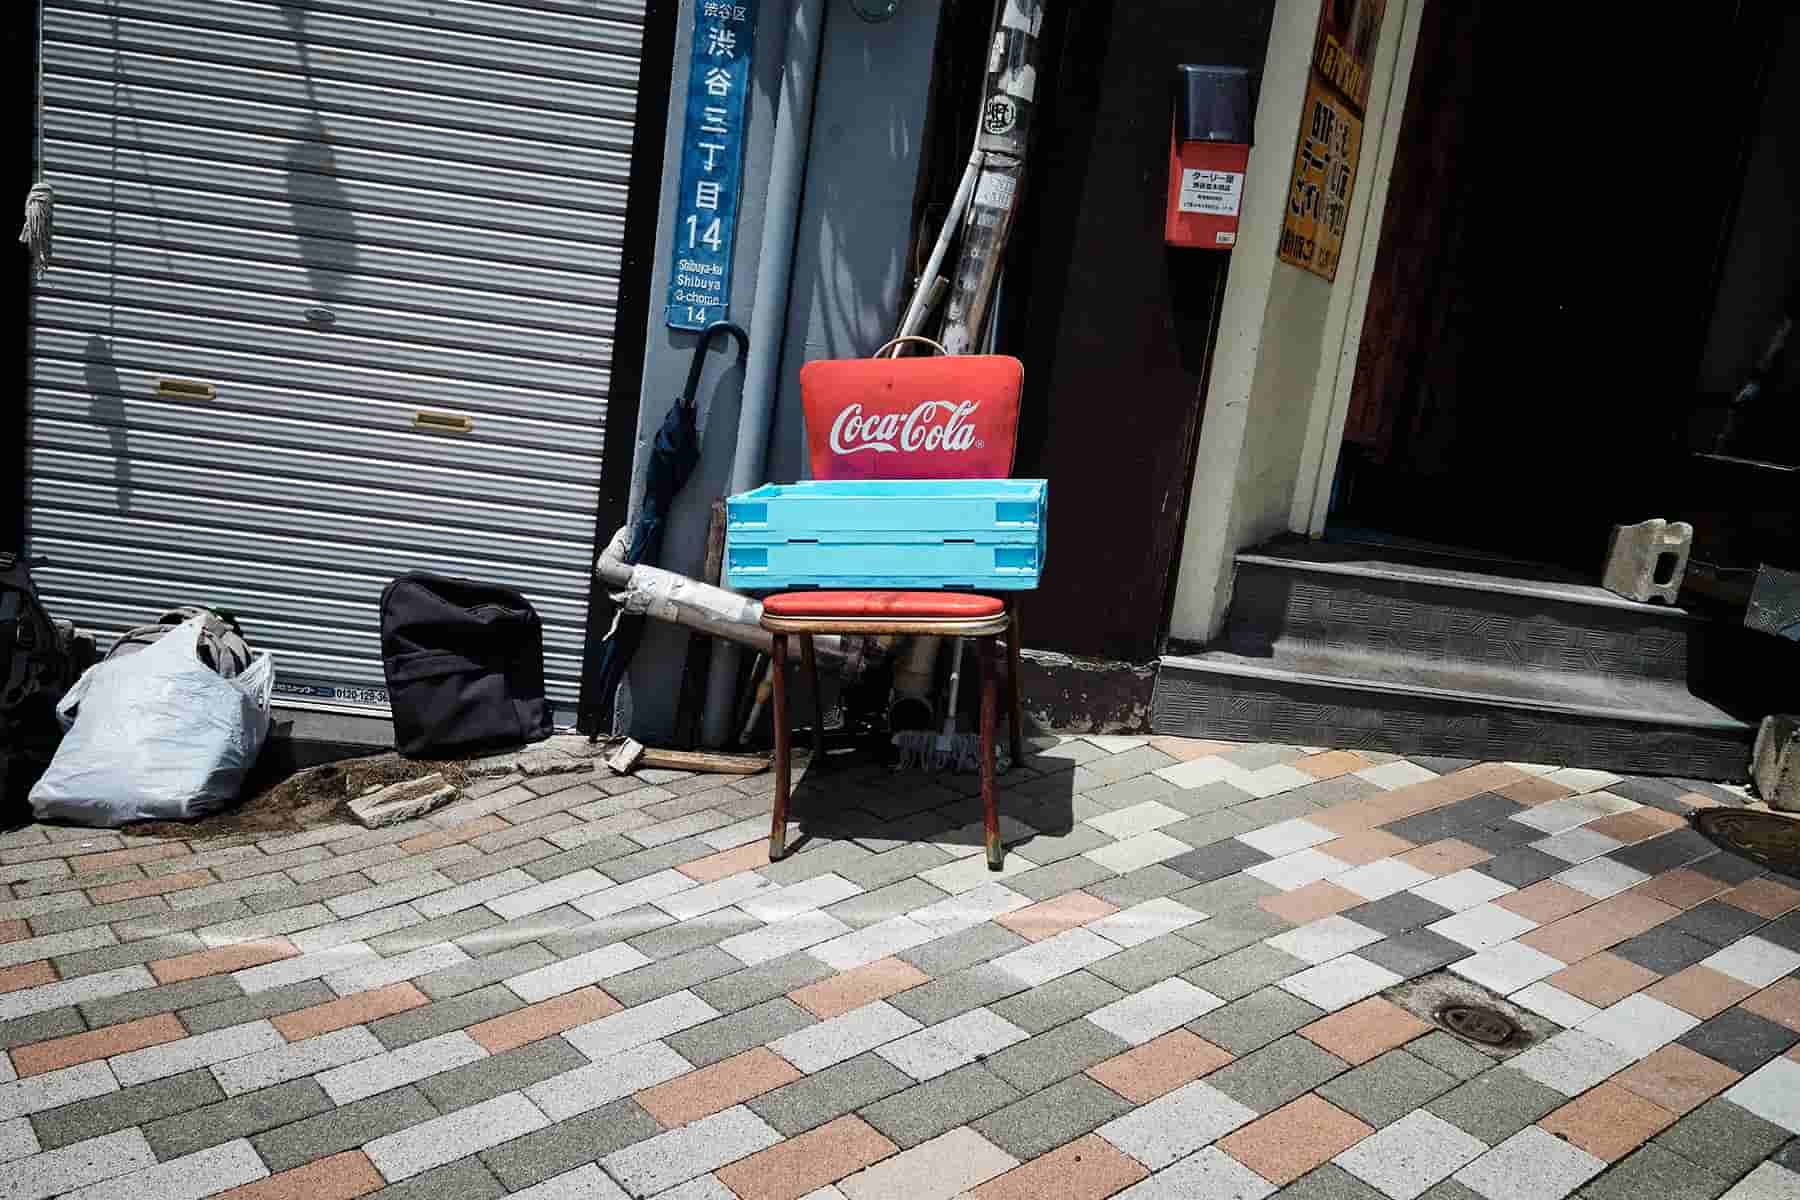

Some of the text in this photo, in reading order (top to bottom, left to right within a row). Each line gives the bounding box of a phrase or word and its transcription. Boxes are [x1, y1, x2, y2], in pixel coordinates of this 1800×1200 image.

[704, 1, 746, 21] 渋谷区
[687, 214, 722, 252] 14
[677, 274, 721, 291] Shibuya
[687, 306, 705, 323] 14
[830, 399, 981, 455] Coca-Cola
